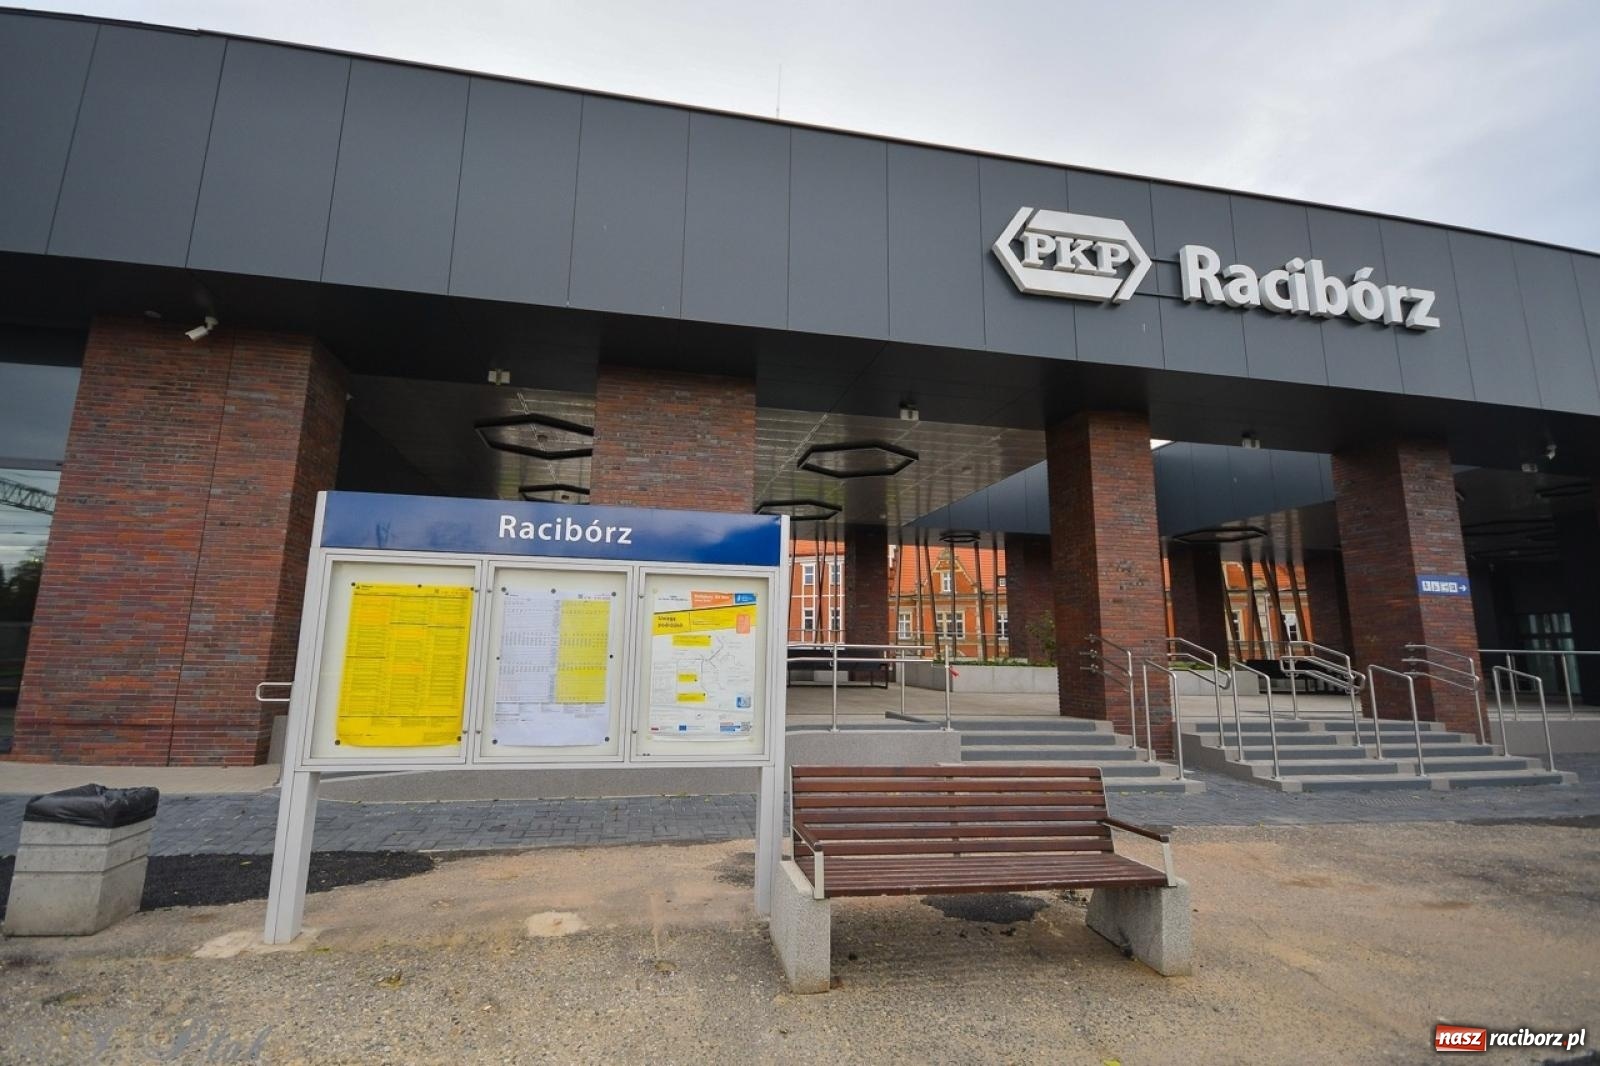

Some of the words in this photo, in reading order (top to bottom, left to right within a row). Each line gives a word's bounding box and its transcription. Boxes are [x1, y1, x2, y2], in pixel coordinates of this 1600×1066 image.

[1021, 231, 1131, 275] PKP
[1179, 244, 1440, 330] Racibórz
[499, 514, 633, 545] Racibórz
